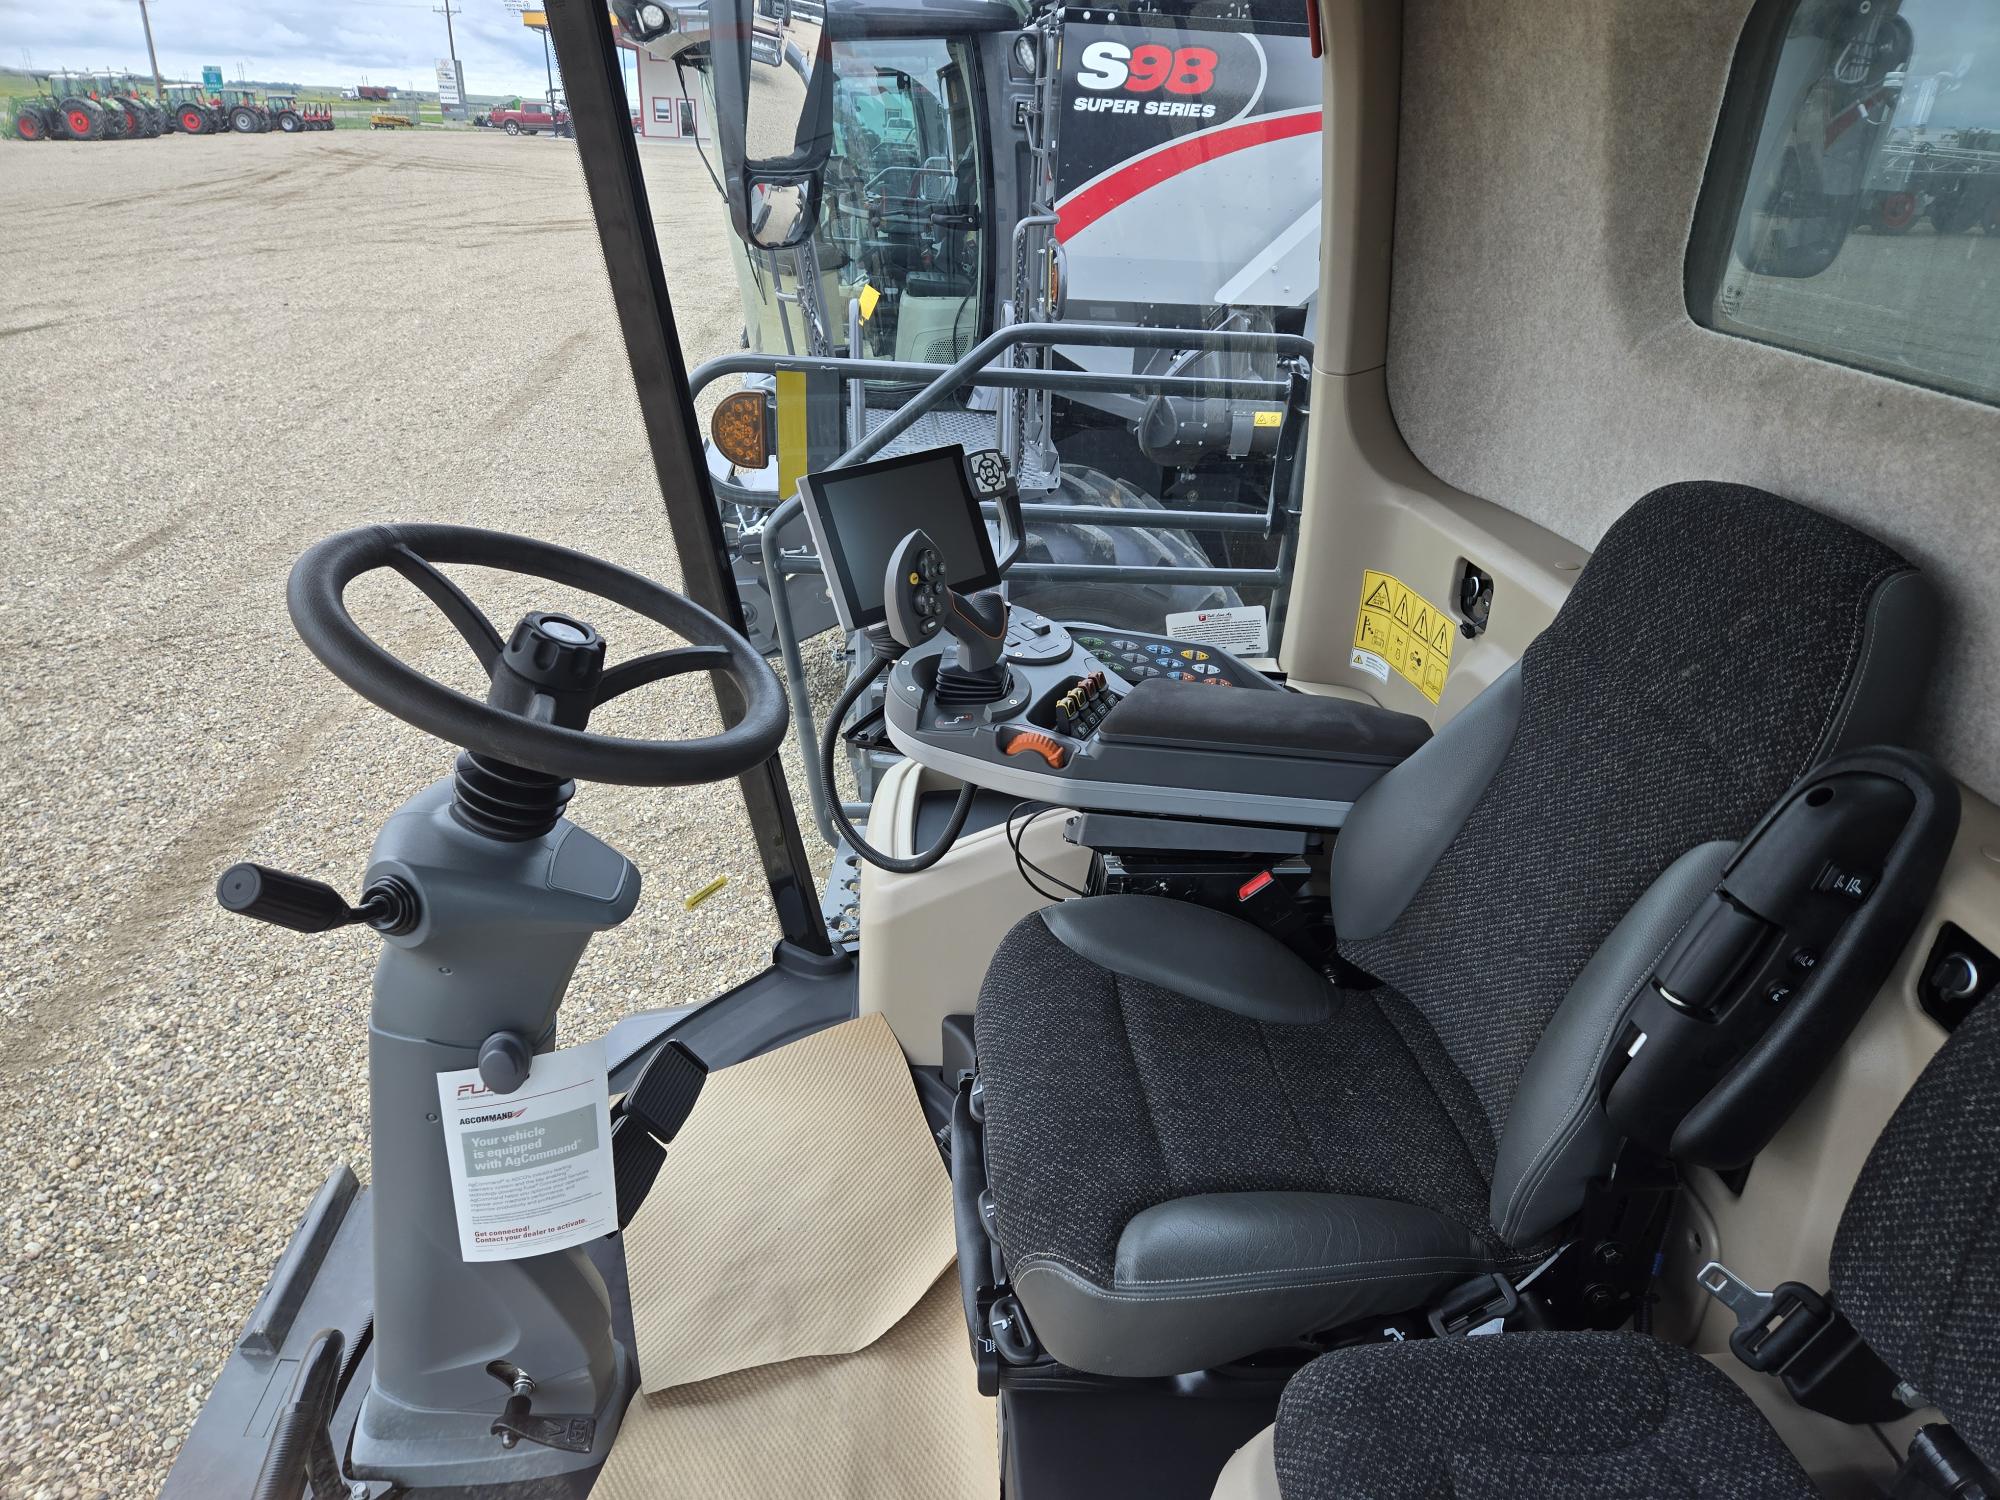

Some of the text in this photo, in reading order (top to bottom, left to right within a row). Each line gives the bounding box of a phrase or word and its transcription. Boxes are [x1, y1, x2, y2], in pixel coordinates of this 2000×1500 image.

[1077, 41, 1219, 95] S98
[1073, 97, 1216, 118] SUPER SERIES
[459, 1111, 514, 1126] AGCOMMAND
[472, 1127, 545, 1147] Your vehicle
[473, 1138, 542, 1159] is equipped
[474, 1158, 501, 1170] with
[474, 1225, 530, 1238] Get connected!
[475, 1236, 503, 1244] Contact
[504, 1233, 522, 1242] your
[523, 1228, 547, 1239] dealer
[556, 1218, 588, 1231] activate.
